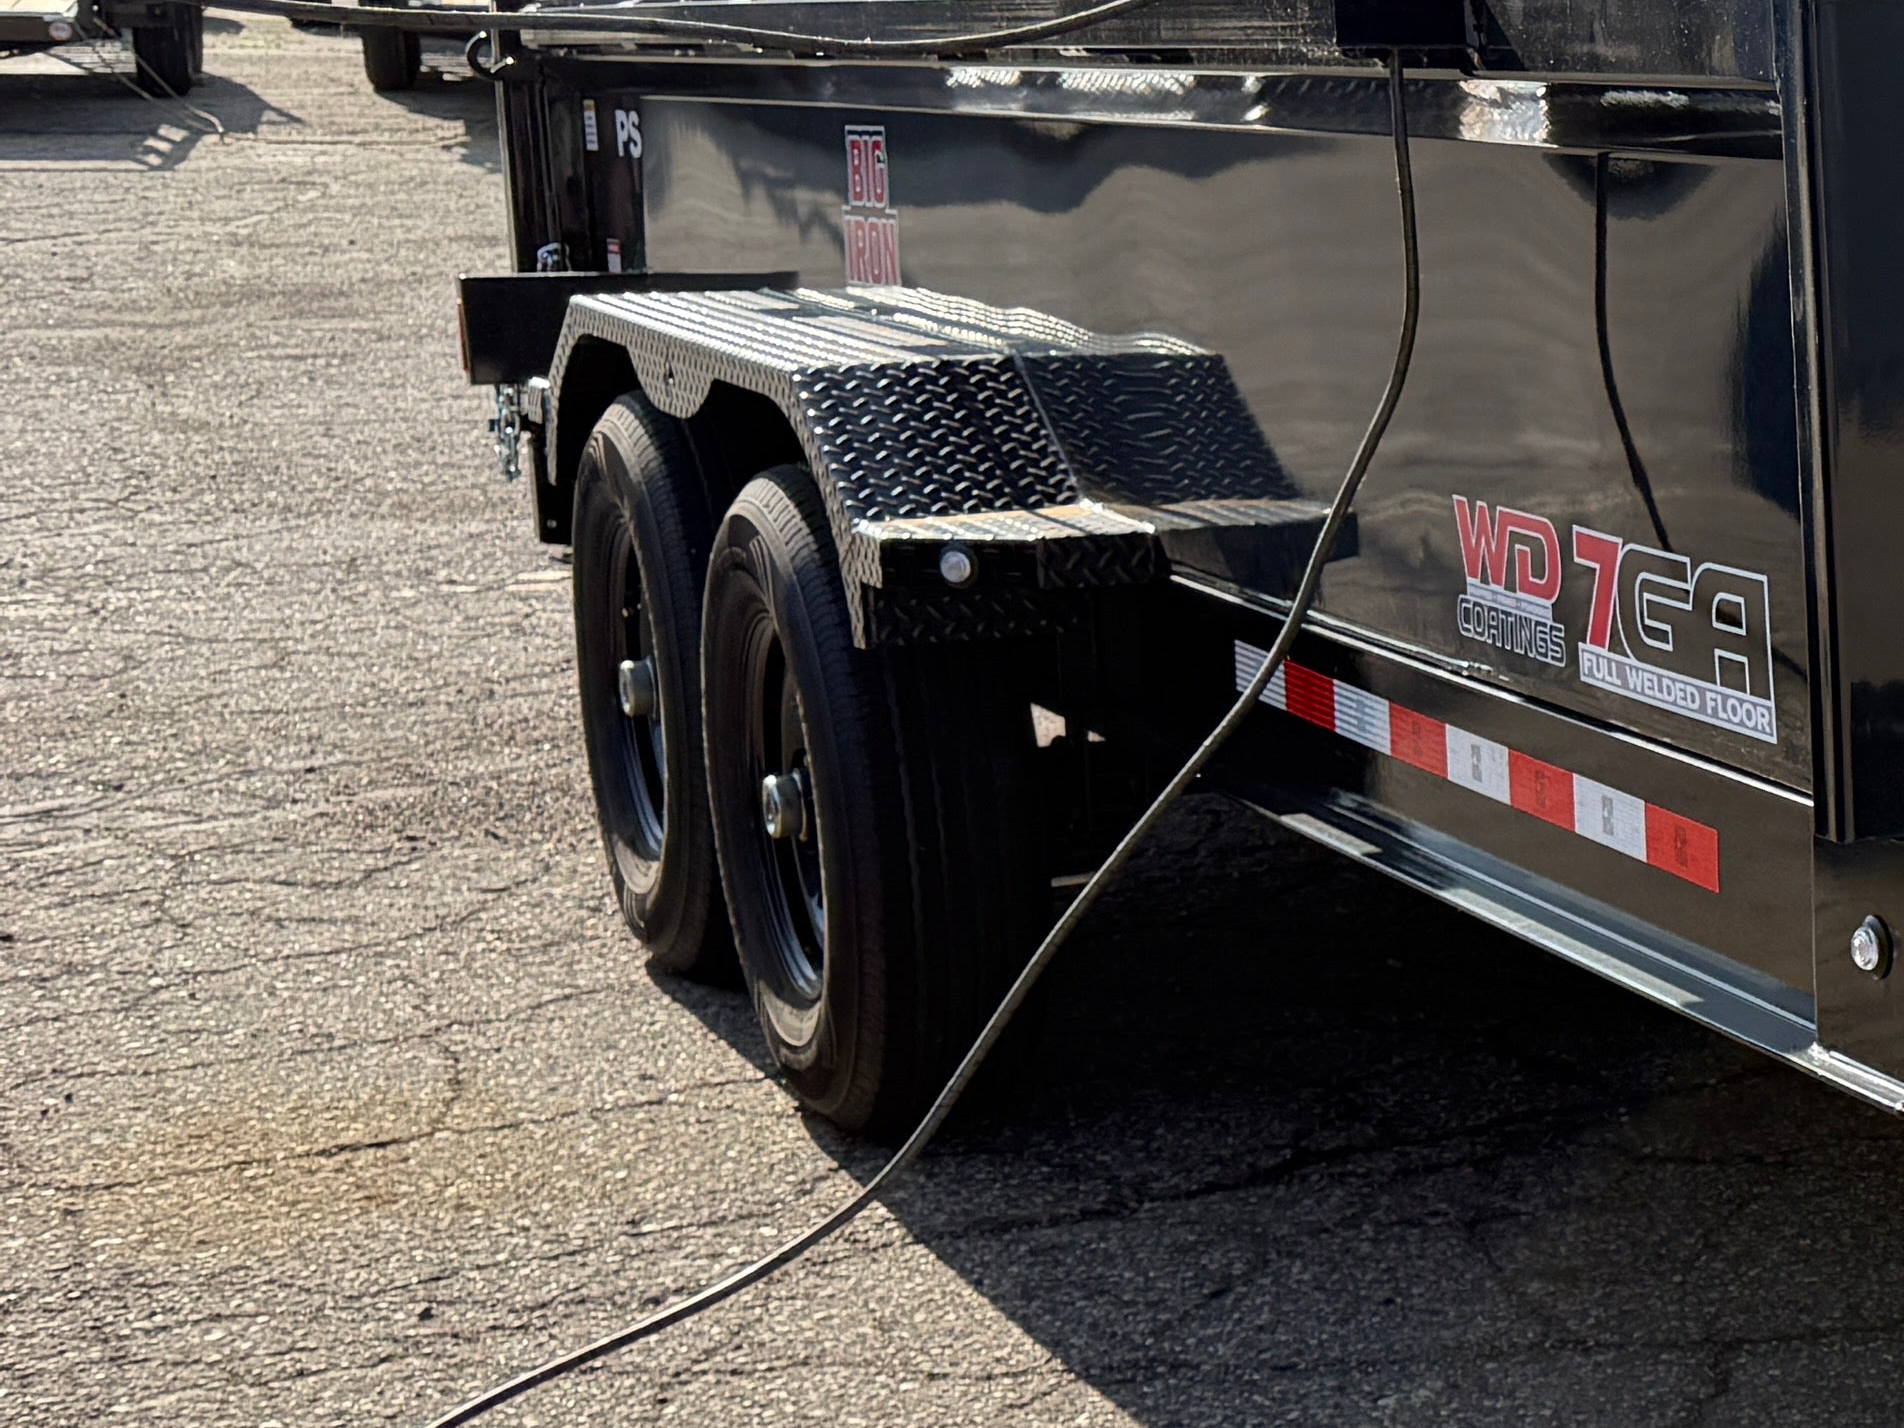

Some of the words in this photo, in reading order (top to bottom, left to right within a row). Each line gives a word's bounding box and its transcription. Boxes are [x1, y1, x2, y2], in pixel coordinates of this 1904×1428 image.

[615, 109, 642, 158] PS
[848, 135, 886, 207] BIG
[845, 215, 899, 286] IRON
[1453, 495, 1561, 605] WD
[1457, 594, 1566, 668] COATINGS
[1582, 655, 1622, 688] FULL
[1626, 664, 1701, 711] WELDED
[1705, 693, 1773, 735] FLOOR
